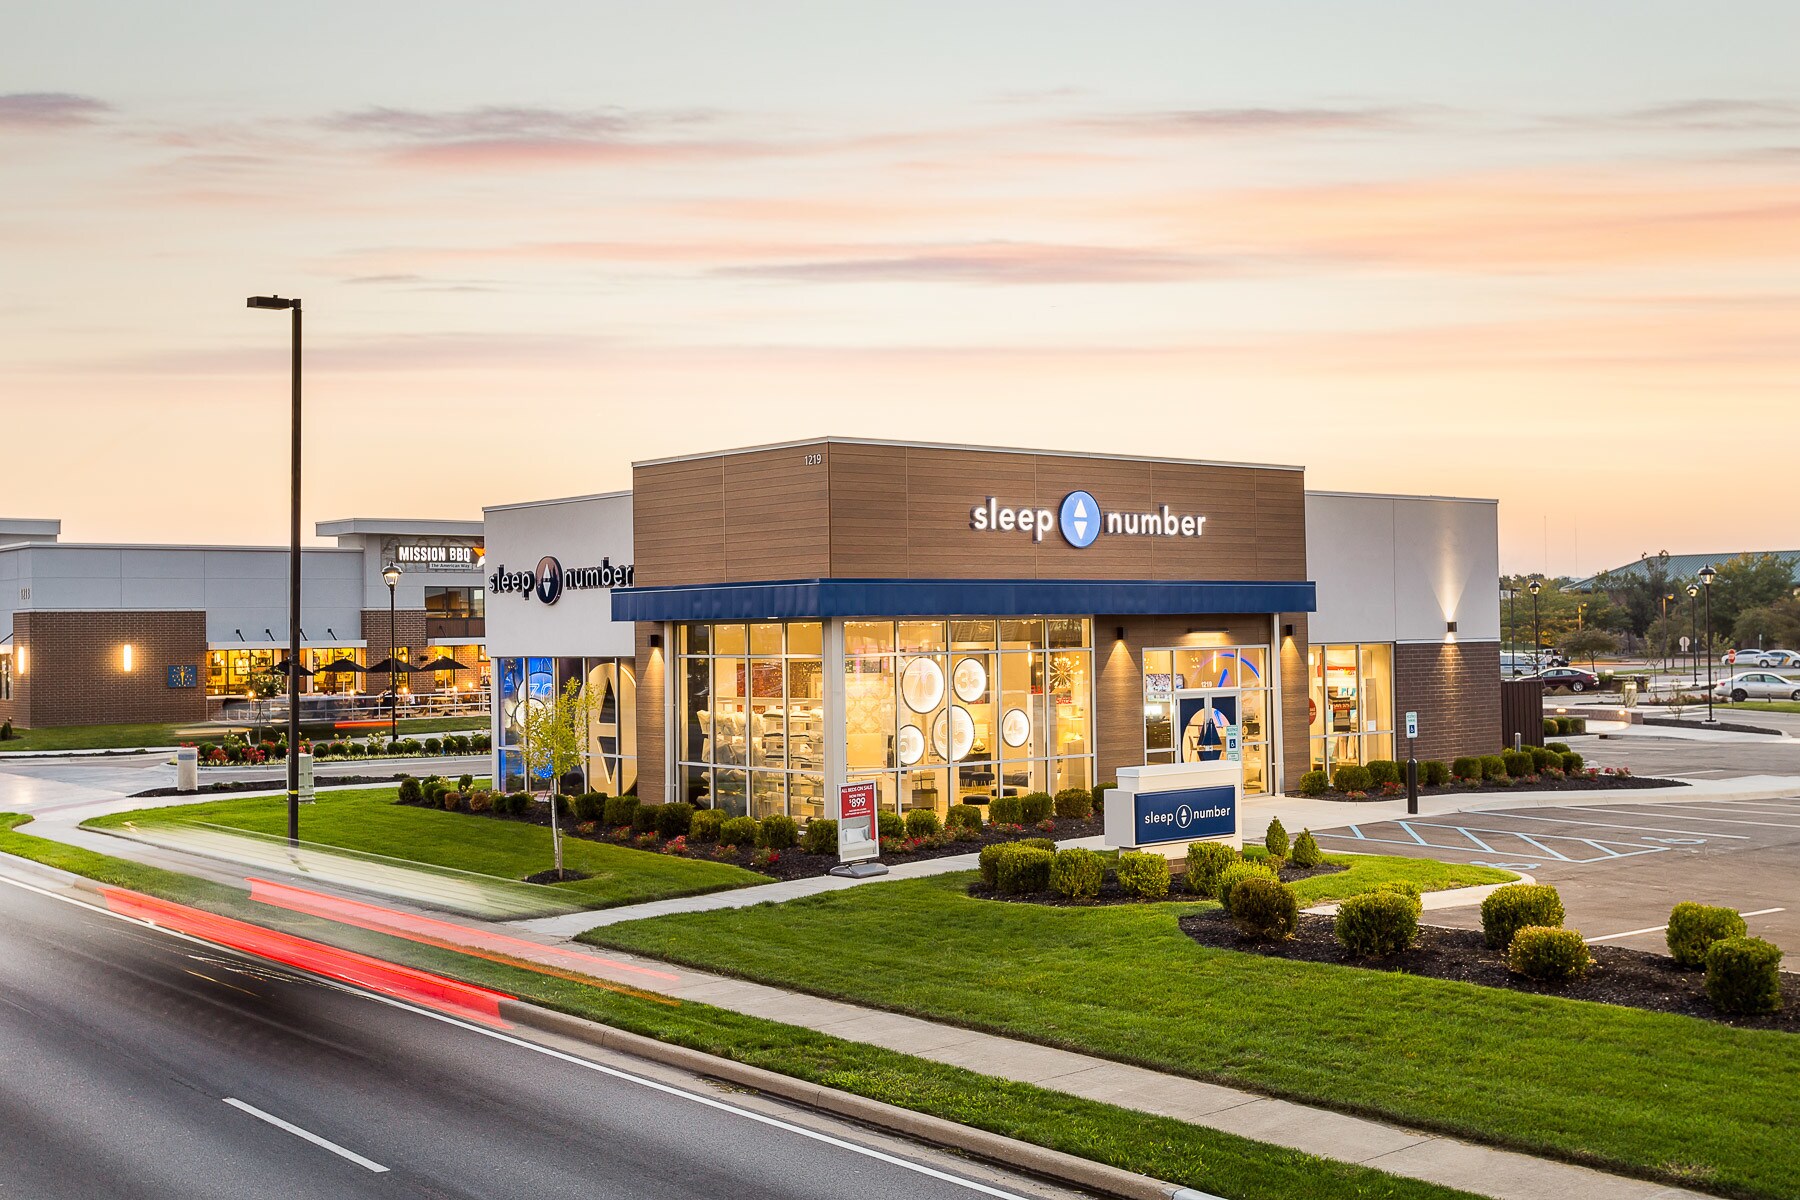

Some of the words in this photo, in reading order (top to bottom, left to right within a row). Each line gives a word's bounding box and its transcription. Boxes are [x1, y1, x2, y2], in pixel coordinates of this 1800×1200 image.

[805, 454, 821, 465] 1219
[971, 497, 1053, 543] sleep
[1105, 504, 1206, 537] number
[399, 546, 446, 561] MISSION
[449, 547, 471, 562] BBQ
[489, 564, 534, 600] sleep
[564, 557, 634, 590] number
[849, 797, 865, 807] $899
[1145, 811, 1173, 826] sleep
[1193, 805, 1231, 819] number
